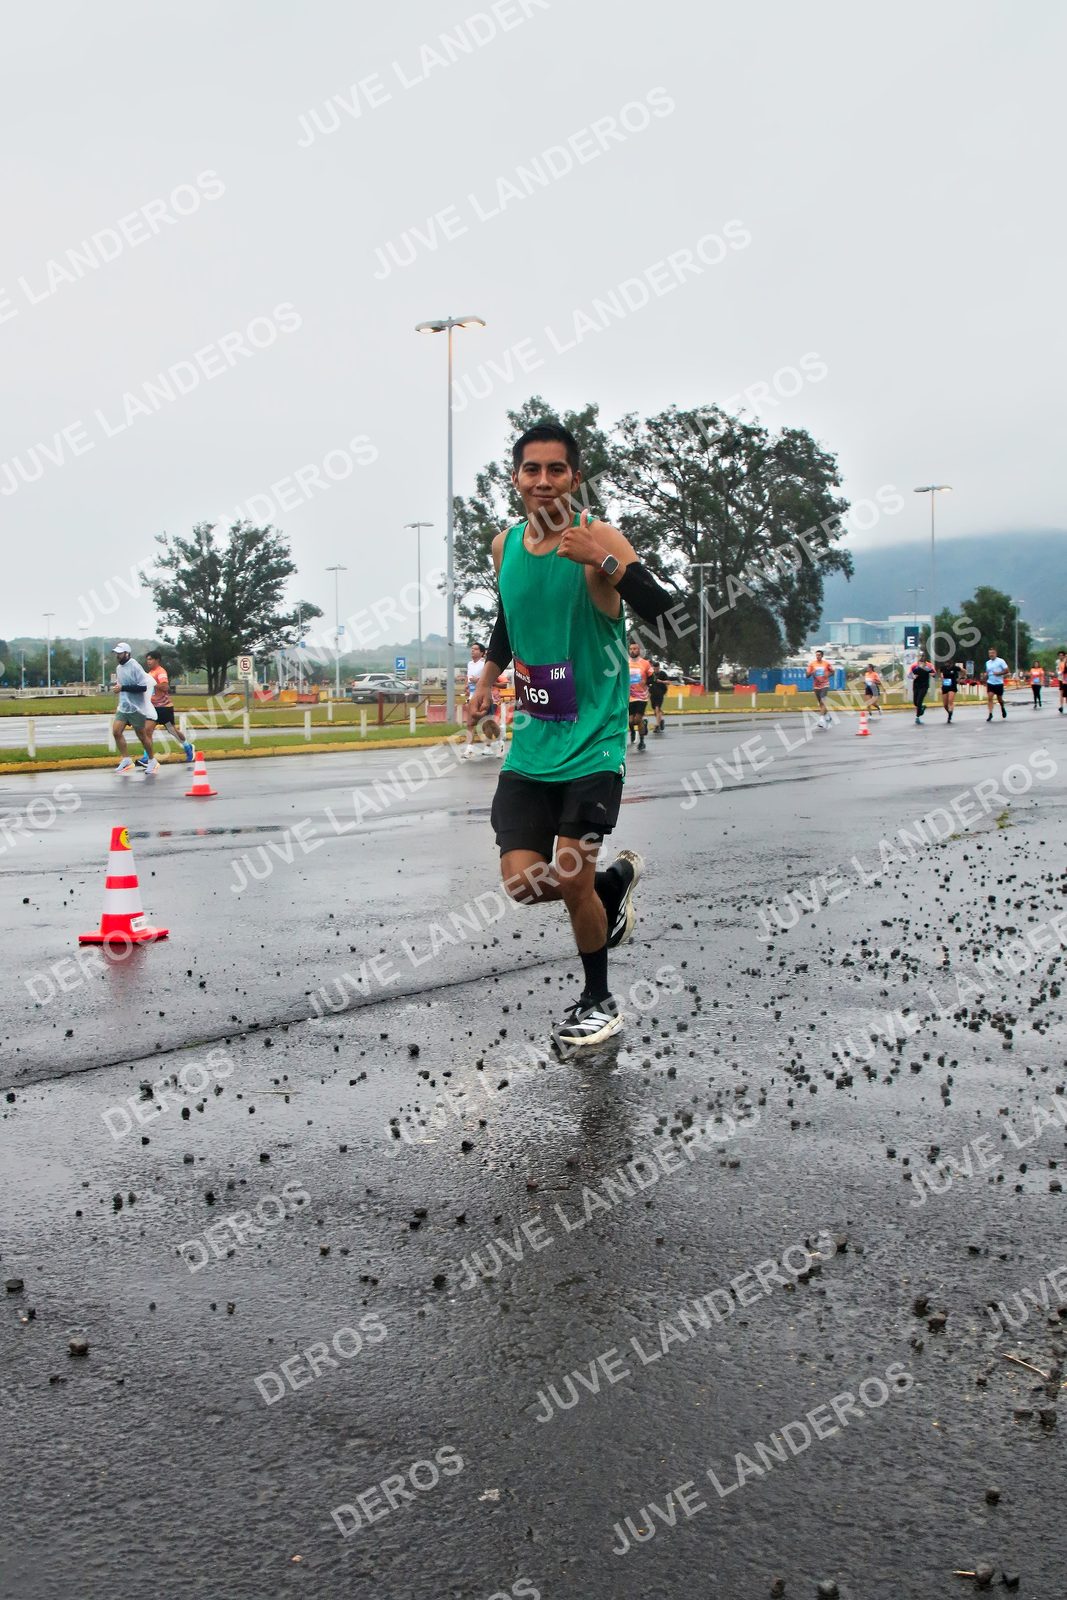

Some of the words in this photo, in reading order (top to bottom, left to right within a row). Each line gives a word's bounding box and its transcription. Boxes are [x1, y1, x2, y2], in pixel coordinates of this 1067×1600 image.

[906, 635, 915, 647] E
[550, 667, 566, 680] 15K
[523, 685, 549, 704] 169
